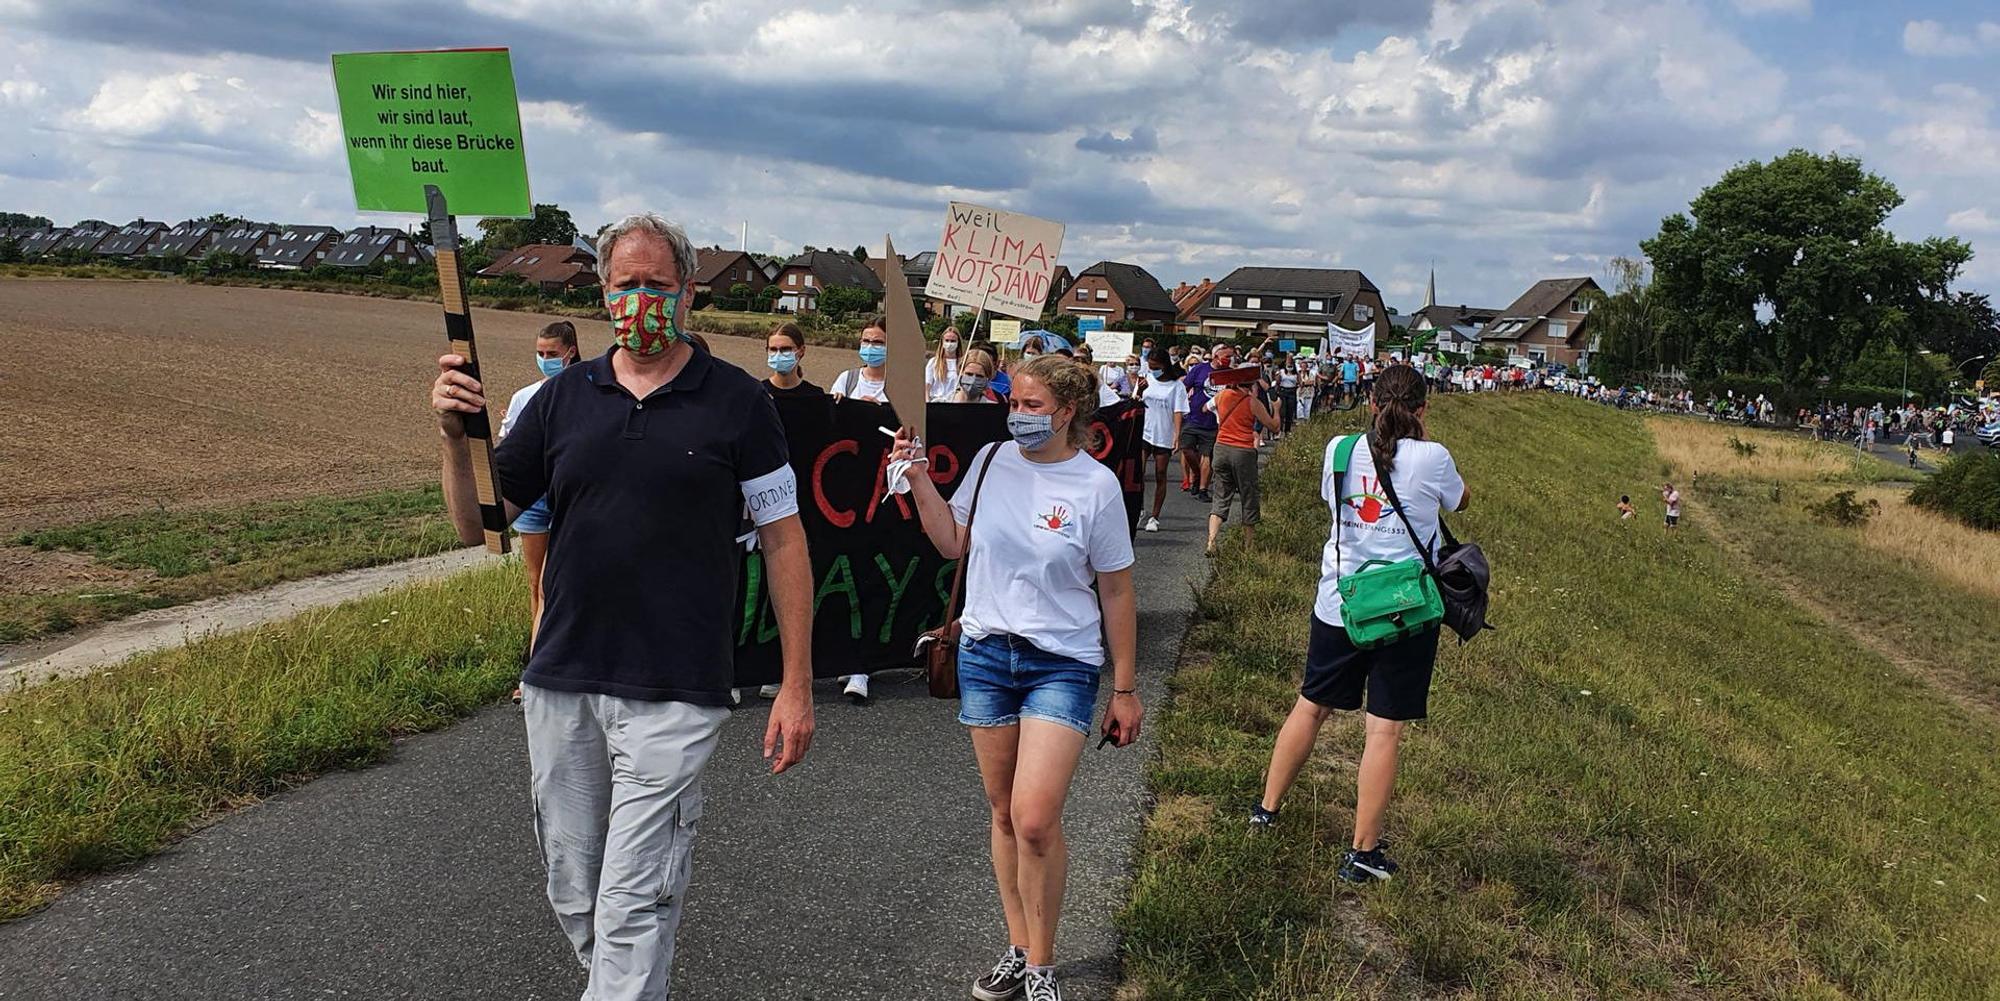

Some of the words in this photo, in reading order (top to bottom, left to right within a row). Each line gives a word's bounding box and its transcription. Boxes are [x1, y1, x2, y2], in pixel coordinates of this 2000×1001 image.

[372, 84, 396, 100] Wir
[401, 84, 432, 100] sind
[437, 83, 471, 102] hier,
[378, 109, 399, 125] wir
[403, 109, 434, 125] sind
[439, 109, 473, 127] laut,
[350, 136, 386, 149] wenn
[390, 134, 408, 149] ihr
[413, 134, 452, 150] diese
[456, 134, 515, 150] Brücke
[412, 157, 448, 173] baut.
[952, 205, 1002, 233] Weil
[944, 223, 1056, 271] KLIMA-
[936, 253, 1050, 304] NOTSTAND
[749, 475, 796, 511] ORDNE
